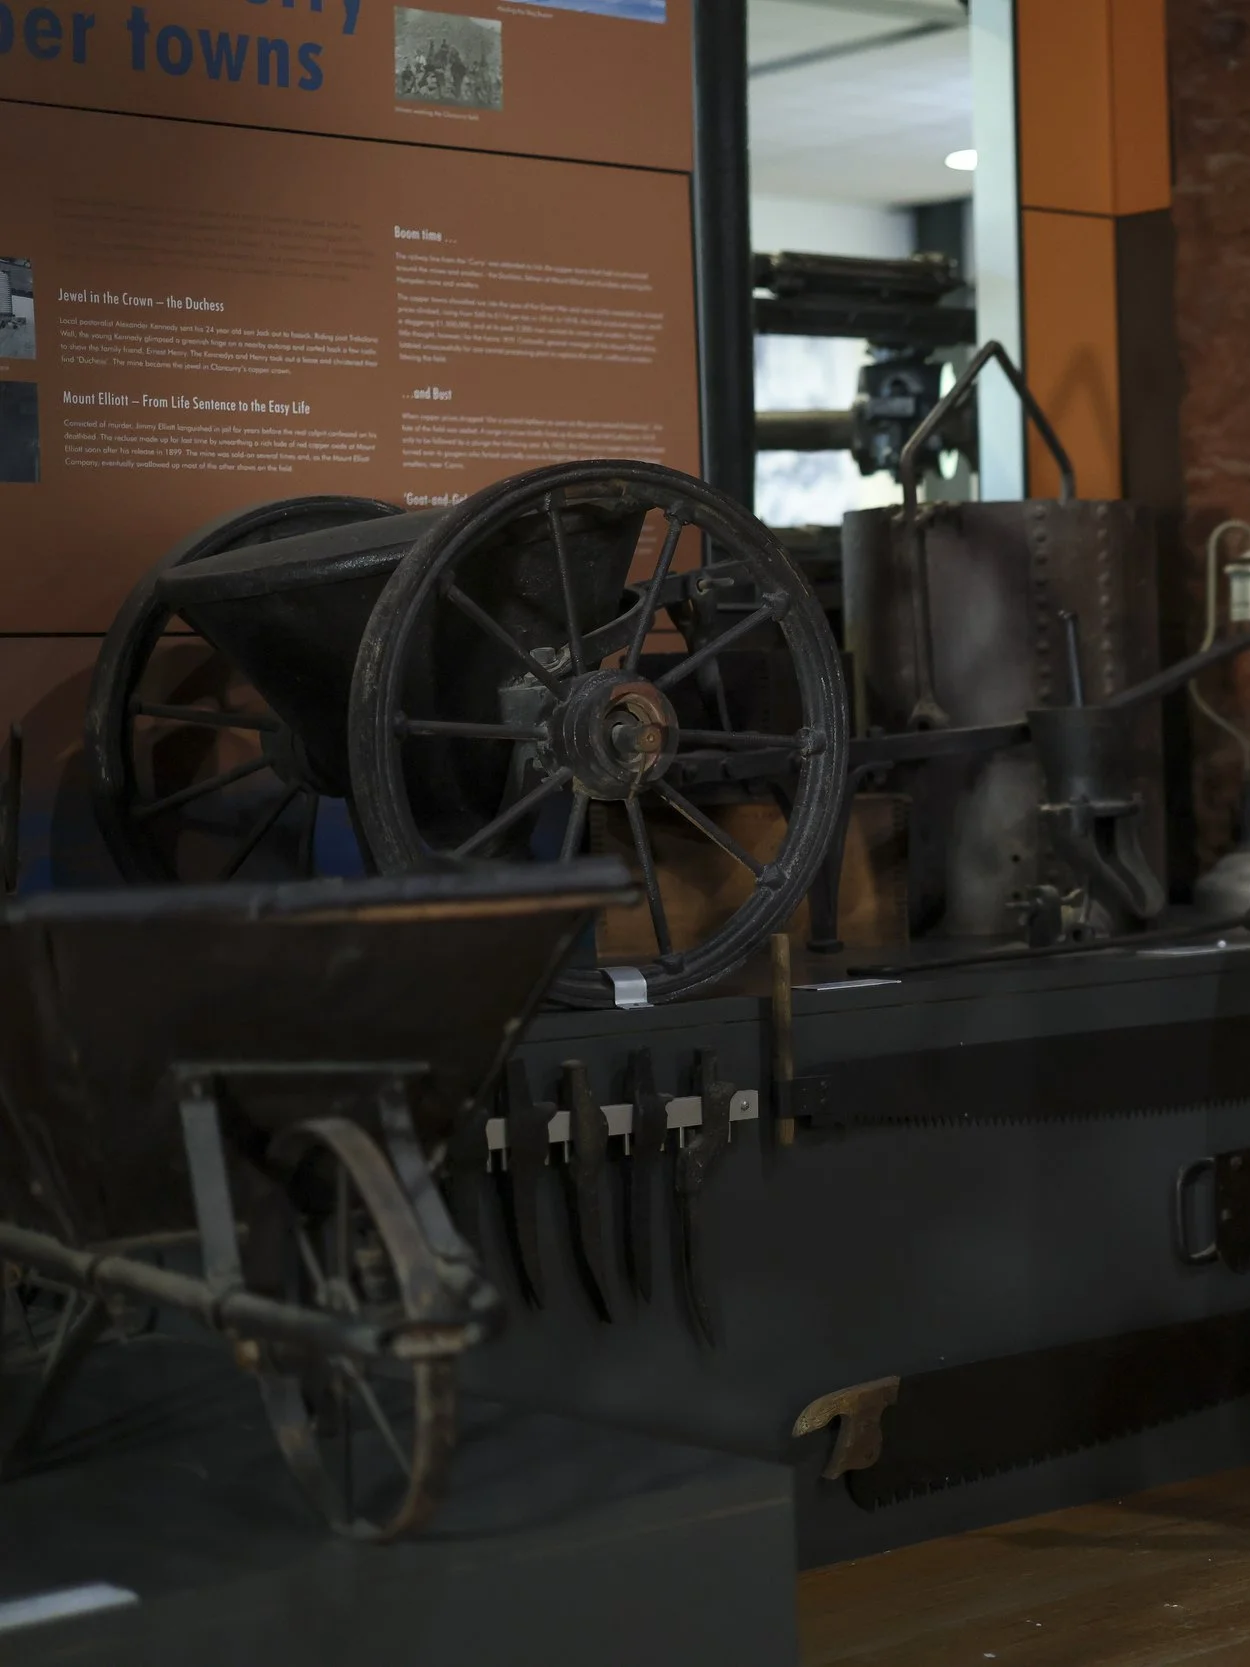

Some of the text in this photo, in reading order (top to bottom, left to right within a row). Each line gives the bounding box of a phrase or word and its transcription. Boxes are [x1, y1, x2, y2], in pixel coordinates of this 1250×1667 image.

[126, 5, 324, 91] towns
[394, 225, 420, 240] Boom
[422, 229, 442, 242] time
[58, 288, 86, 302] Jewel
[90, 291, 100, 304] in
[103, 291, 119, 305] the
[122, 292, 153, 307] Crown
[166, 296, 183, 309] the
[185, 297, 224, 312] Duchess
[59, 317, 77, 325] Local
[79, 319, 114, 328] pastoralist
[115, 320, 148, 329] Alexander
[150, 323, 178, 332] Kennedy
[205, 325, 214, 333] 24
[91, 333, 112, 341] young
[113, 333, 142, 342] Kennedy
[100, 345, 121, 353] family
[113, 358, 125, 366] The
[63, 391, 95, 405] Mount
[98, 392, 129, 406] Elliott
[142, 394, 168, 408] From
[171, 395, 190, 409] Life
[192, 396, 236, 411] Sentence
[239, 400, 248, 411] to
[250, 398, 266, 412] the
[268, 400, 290, 416] Easy
[292, 400, 311, 415] Life
[63, 418, 98, 427] Convicted
[99, 420, 106, 428] of
[135, 422, 156, 431] Jimmy
[157, 422, 175, 431] Elliott
[177, 424, 212, 433] languished
[209, 437, 217, 446] by
[64, 445, 83, 453] Elliott
[102, 446, 118, 454] after
[101, 459, 134, 468] eventually
[136, 460, 170, 468] swallowed
